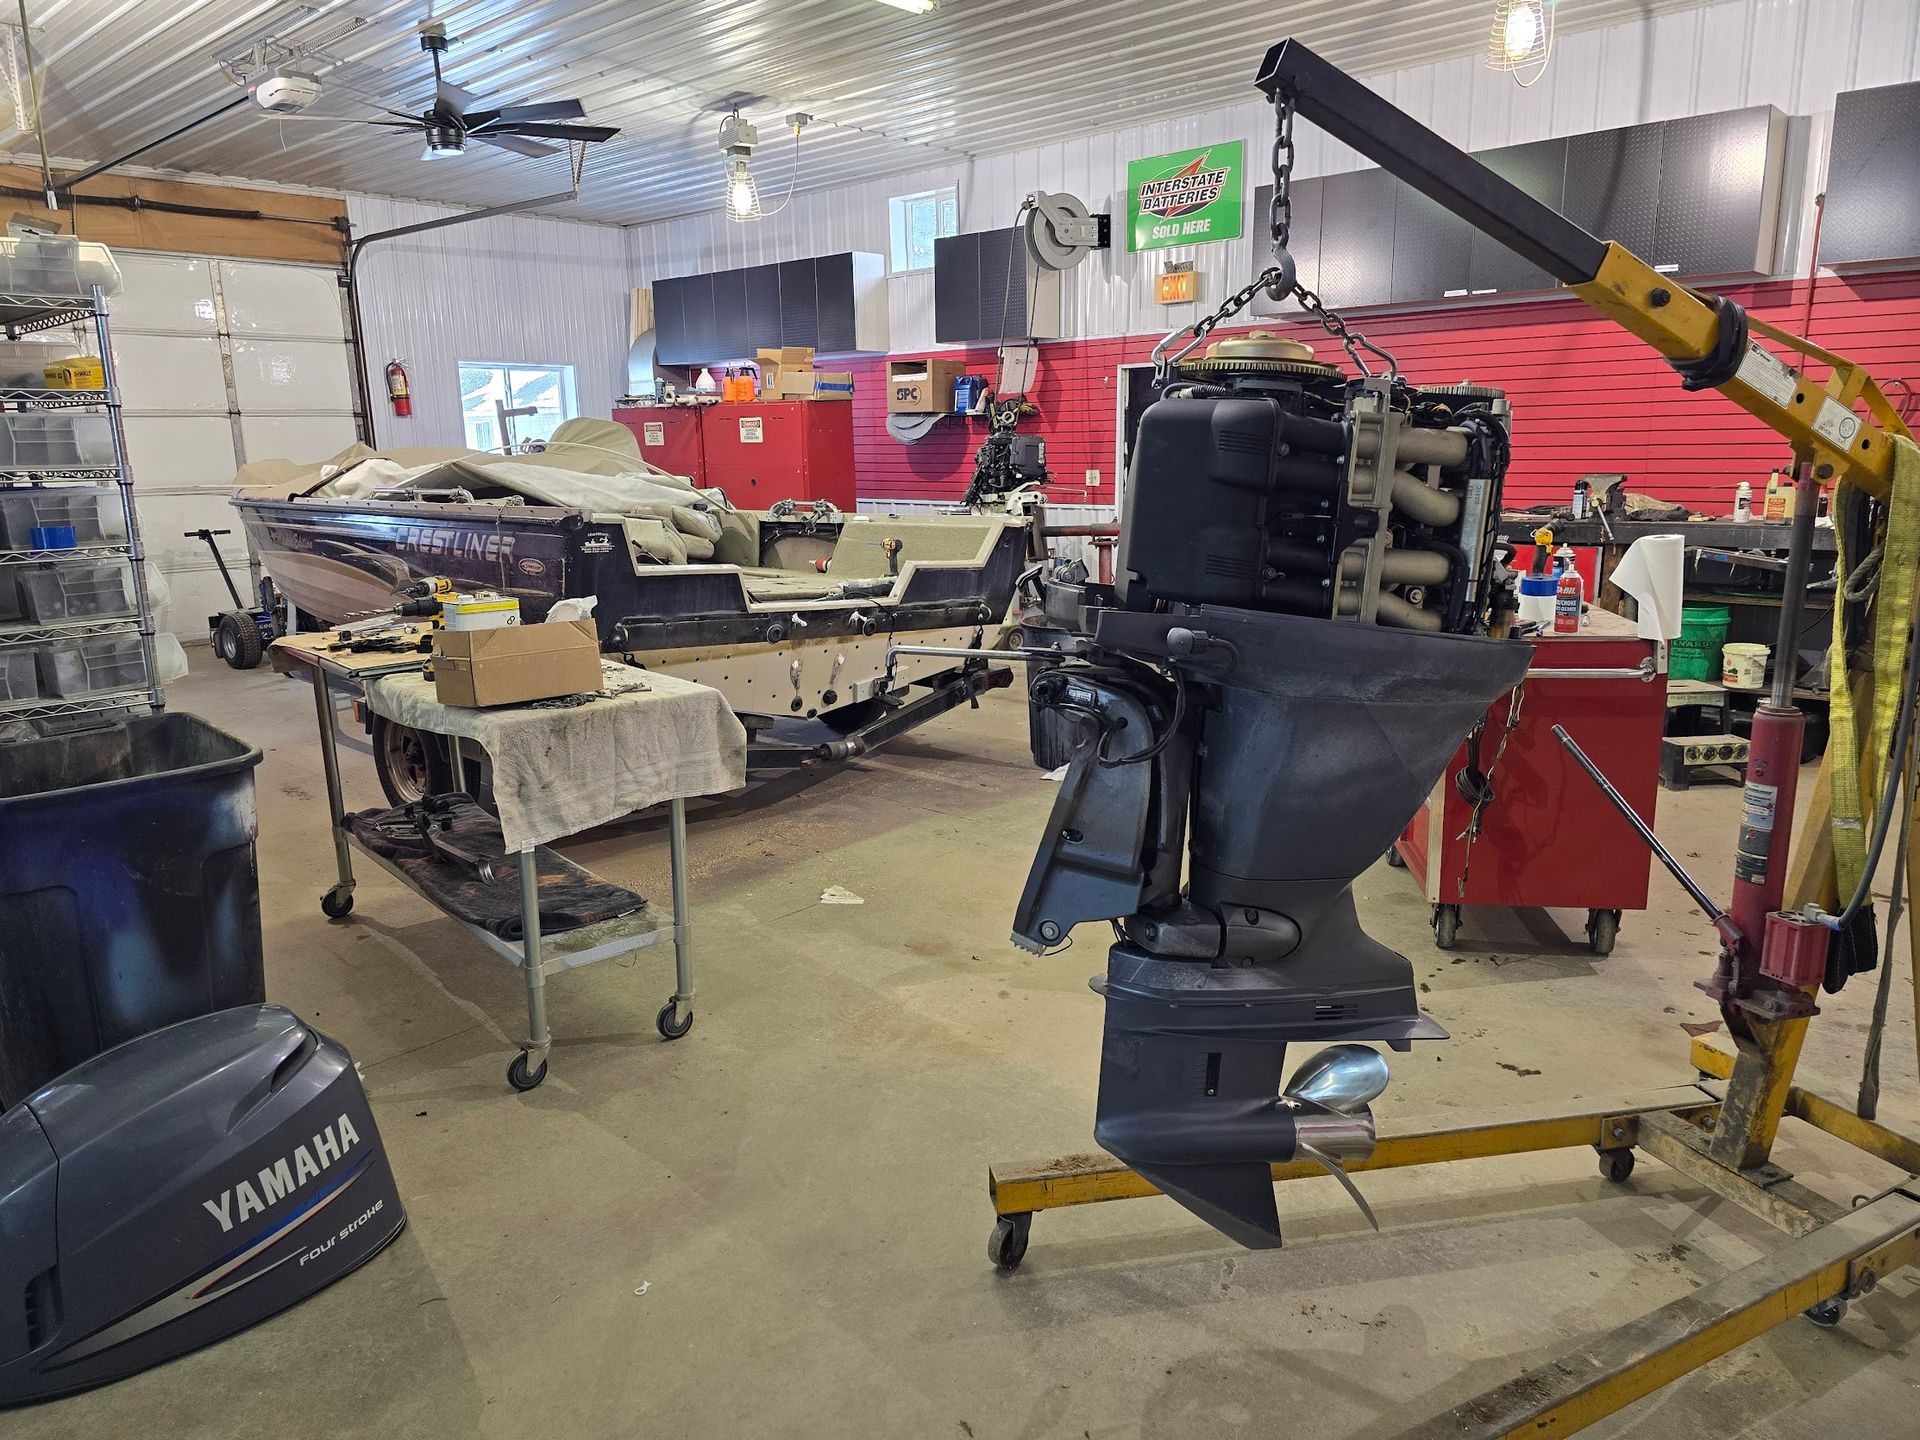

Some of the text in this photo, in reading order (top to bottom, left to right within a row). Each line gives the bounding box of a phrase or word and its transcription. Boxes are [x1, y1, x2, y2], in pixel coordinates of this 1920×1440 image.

[1141, 170, 1225, 196] INTERSTATE
[1143, 187, 1218, 210] BATTERIES
[1152, 218, 1212, 240] SOLD HERE
[1161, 275, 1186, 301] EXIT
[896, 387, 918, 401] SPC
[395, 526, 516, 564] CRESTLINER
[1671, 638, 1713, 649] ENARD
[202, 1112, 361, 1233] YAMAHA
